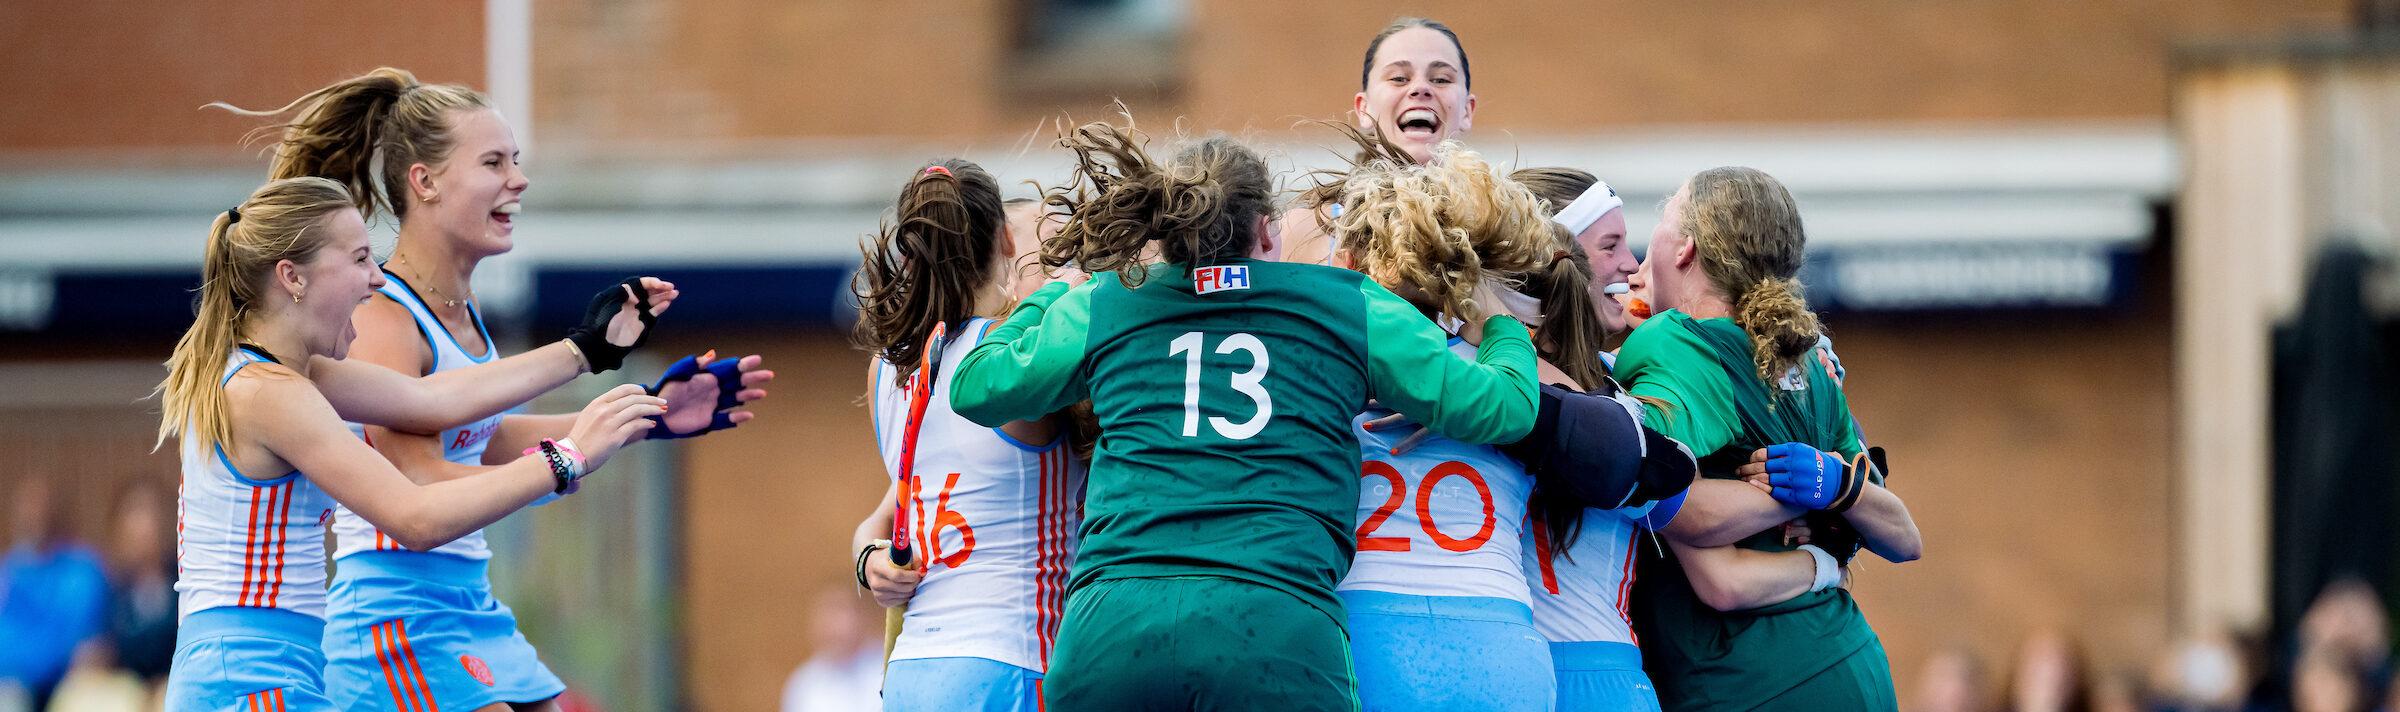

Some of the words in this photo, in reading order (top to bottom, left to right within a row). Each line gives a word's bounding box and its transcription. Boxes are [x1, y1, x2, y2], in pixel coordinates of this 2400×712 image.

[1168, 331, 1273, 440] 13
[912, 472, 976, 569] 16
[1355, 460, 1497, 553] 20
